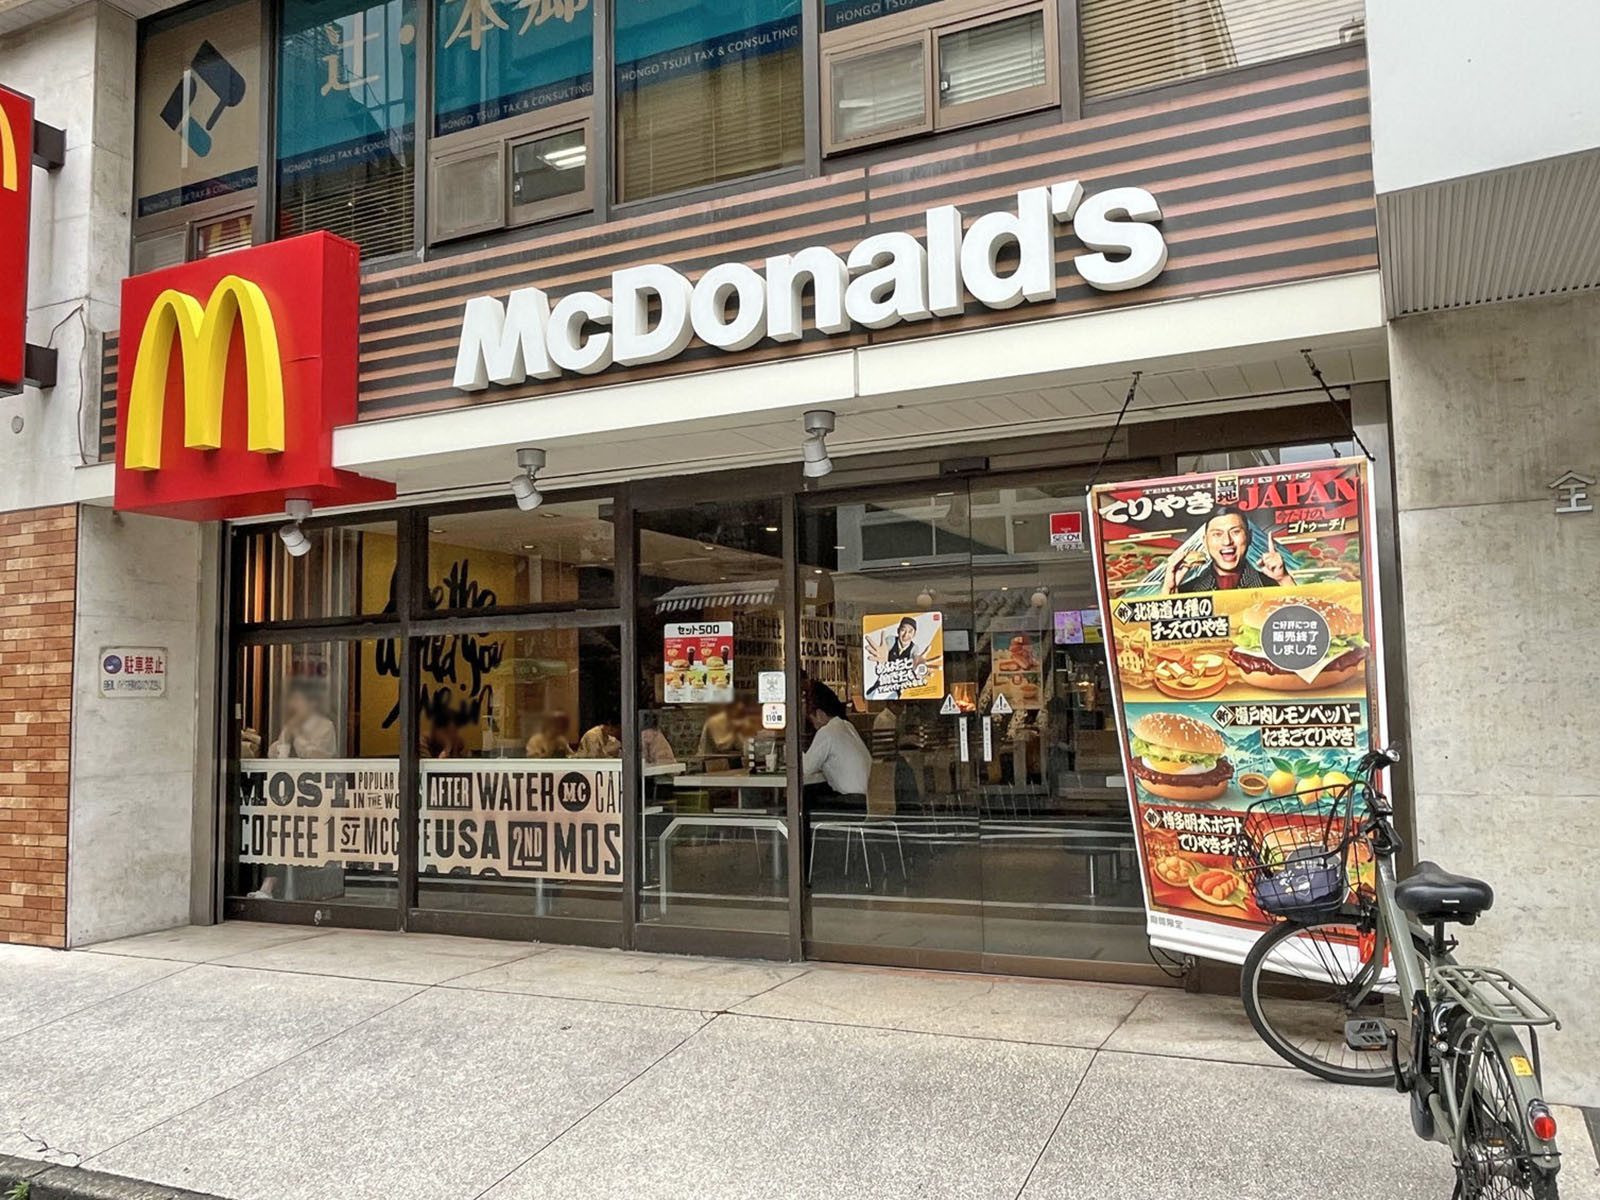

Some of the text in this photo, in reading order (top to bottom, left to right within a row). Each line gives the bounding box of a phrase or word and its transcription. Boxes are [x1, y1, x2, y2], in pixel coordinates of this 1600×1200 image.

[836, 3, 880, 23] HONGO
[621, 25, 798, 82] HONGO TSUJI TAX & CONSULTING
[440, 115, 474, 130] HONGO
[503, 102, 521, 114] TAX
[531, 82, 592, 107] CONSULTING
[338, 150, 353, 159] TAX
[452, 179, 1168, 392] McDonald's
[1142, 482, 1213, 495] TERIYAKI
[1238, 476, 1359, 512] JAPAN
[1098, 491, 1215, 523] てりやき
[1133, 597, 1212, 621] 北海道4種の
[677, 624, 720, 635] セット500
[1152, 617, 1229, 640] チーズてりやき
[1272, 631, 1319, 643] 販売終了
[1273, 644, 1318, 656] しました
[124, 655, 164, 674] 駐車禁止
[1262, 727, 1354, 747] たまごてりやき
[240, 771, 356, 808] MOST
[358, 771, 394, 790] POPULAR
[353, 792, 365, 809] IN
[367, 796, 382, 807] THE
[430, 776, 470, 807] AFTER
[477, 772, 554, 812] WATER
[561, 782, 587, 803] MC
[1162, 810, 1242, 834] 博多明太ポテト
[240, 815, 319, 859] COFFEE
[435, 818, 500, 860] USA
[512, 826, 543, 866] 2ND
[1177, 834, 1250, 857] てりやきチ
